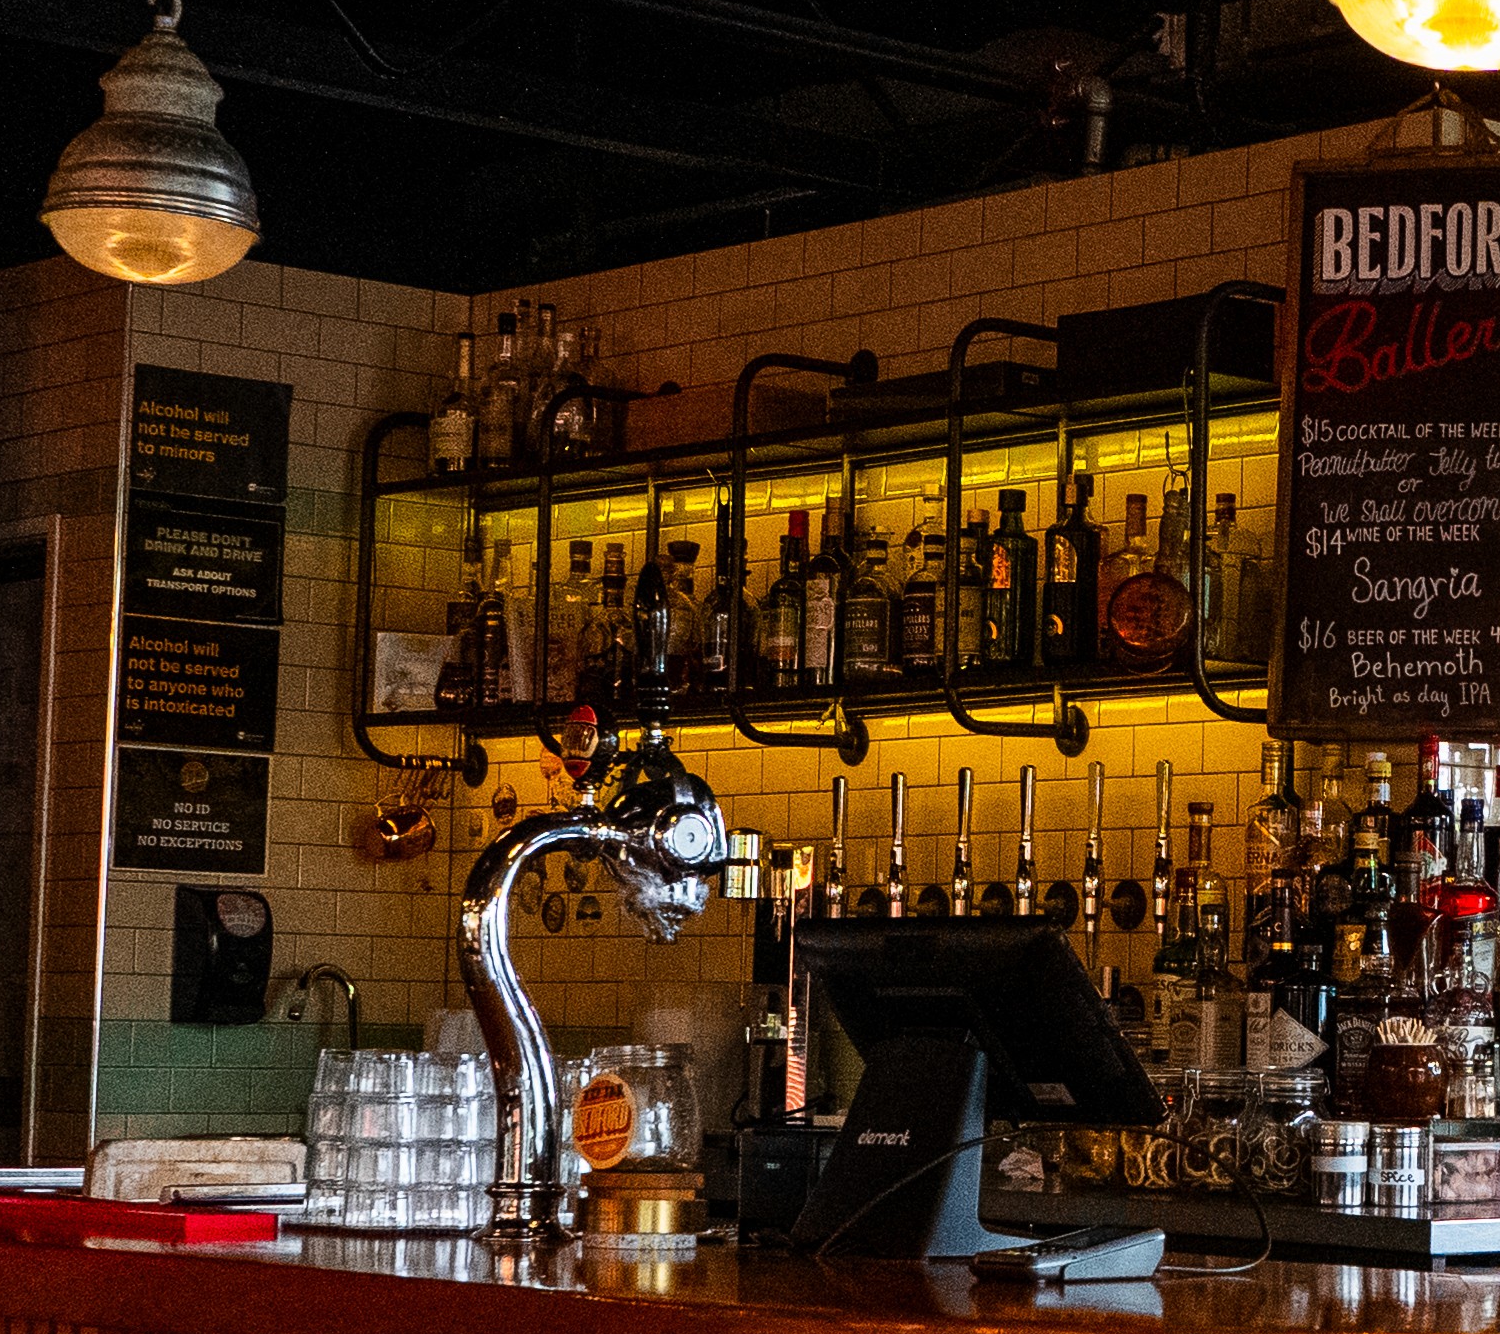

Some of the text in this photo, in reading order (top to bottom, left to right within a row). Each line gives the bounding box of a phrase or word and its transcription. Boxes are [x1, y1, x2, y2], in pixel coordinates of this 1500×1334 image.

[139, 400, 230, 425] Alcohol will
[138, 422, 250, 447] not be served
[1302, 414, 1334, 446] $15
[1336, 423, 1410, 441] COCKTAIL
[1415, 422, 1433, 440] OF
[1439, 422, 1465, 439] THE
[137, 441, 216, 463] to minors
[1429, 446, 1477, 492] Jelly
[1398, 478, 1423, 493] or
[156, 526, 208, 544] PLEASE
[1306, 524, 1480, 559] $14 WINE OF THE WEEK
[144, 538, 263, 563] DRINK AND DRIVE
[172, 567, 232, 582] ASK ABOUT
[146, 577, 257, 599] TRANSPORT OPTIONS
[1352, 556, 1483, 619] Sangria
[129, 635, 220, 658] Alcohol will
[1299, 616, 1336, 655] $16
[1347, 629, 1384, 646] BEER
[1389, 629, 1406, 645] OF
[1412, 628, 1438, 645] THE
[1443, 628, 1481, 645] WEEK
[128, 656, 239, 679] not be served
[1351, 647, 1483, 678] Behemoth
[127, 676, 245, 699] to anyone who
[126, 695, 236, 719] is intoxicated
[1329, 682, 1491, 717] Bright as day IPA
[173, 802, 211, 815] NO ID
[152, 818, 231, 833] NO SERVICE
[137, 835, 243, 852] NO EXCEPTIONS
[857, 1129, 911, 1146] element
